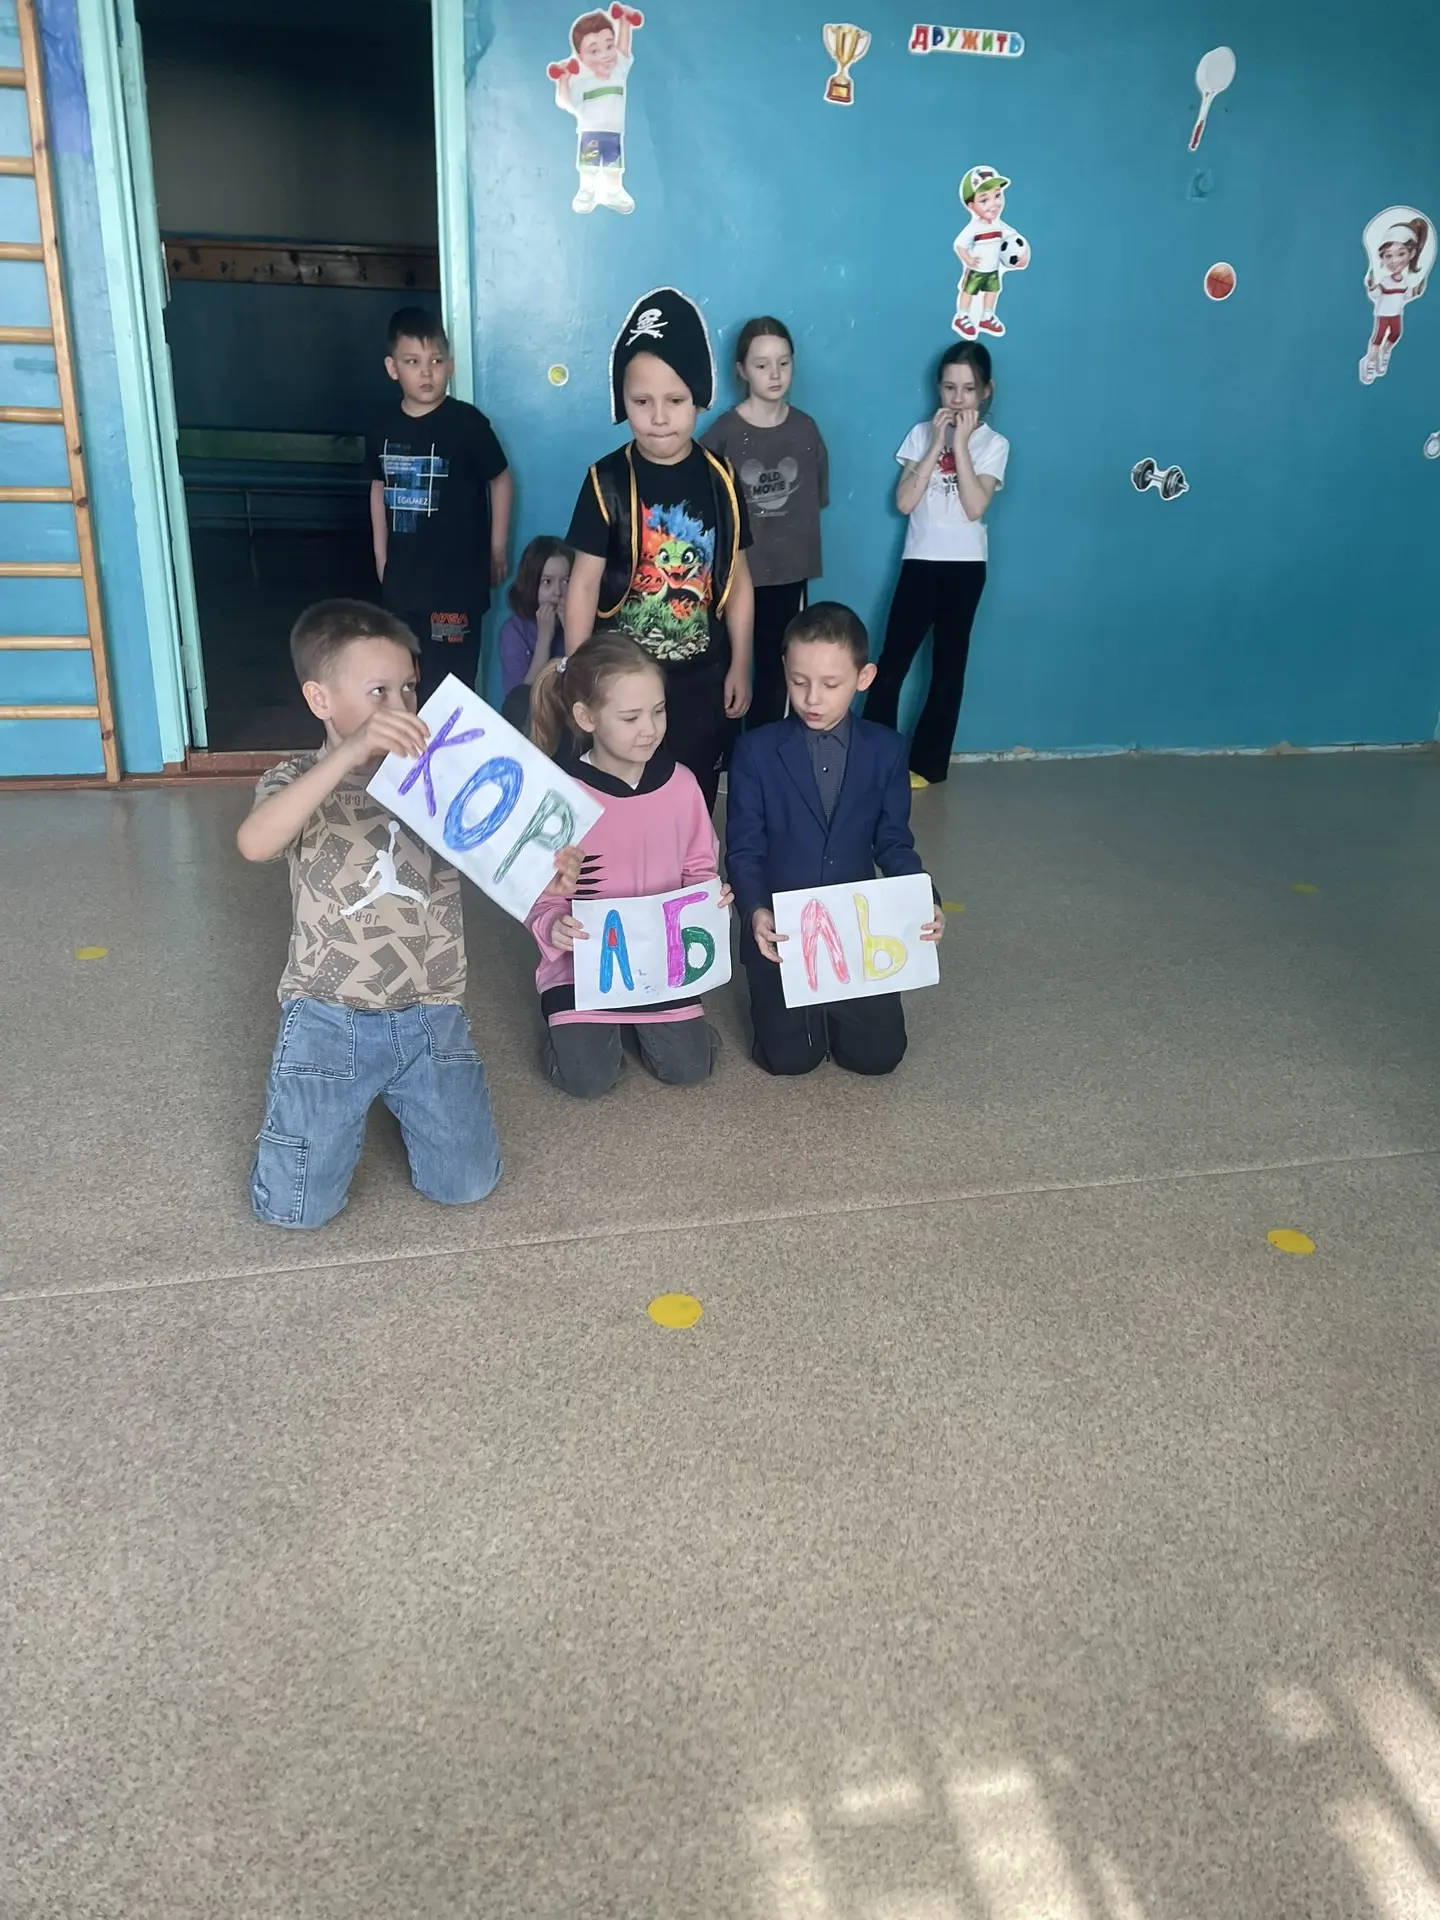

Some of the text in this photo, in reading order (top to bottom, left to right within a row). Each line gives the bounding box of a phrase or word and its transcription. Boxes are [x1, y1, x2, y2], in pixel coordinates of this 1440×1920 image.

[911, 25, 1022, 53] ДРУЖИТЬ
[760, 471, 781, 484] OLD
[600, 891, 716, 994] АБ
[801, 893, 908, 993] ЛЬ
